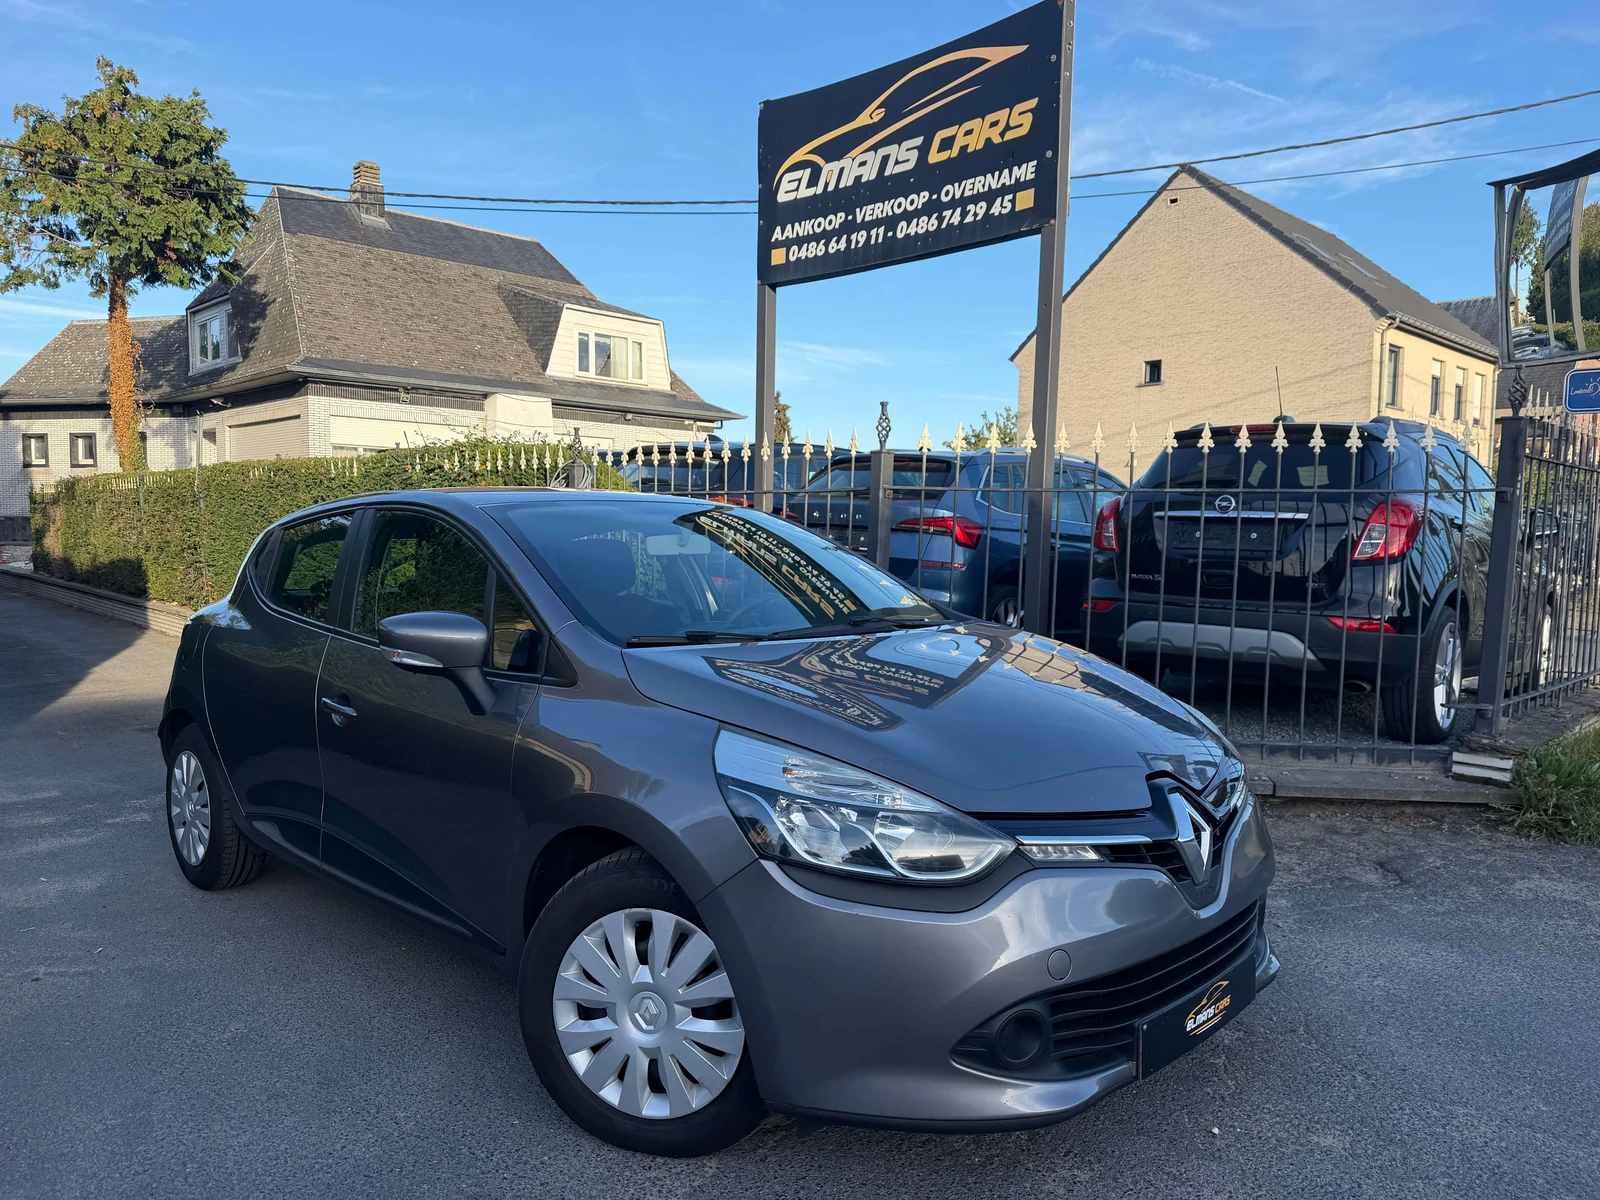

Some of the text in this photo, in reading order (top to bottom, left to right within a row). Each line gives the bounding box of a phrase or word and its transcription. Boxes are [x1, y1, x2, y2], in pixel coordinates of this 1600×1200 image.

[777, 97, 1039, 203] ELMANS CARS
[771, 214, 844, 242] AANKOOP
[856, 191, 929, 222] VERKOOP
[940, 161, 1037, 203] OVERNAME
[789, 241, 825, 262] 0486
[828, 239, 847, 254] 64
[850, 232, 868, 249] 19
[870, 228, 885, 244] 11
[896, 214, 938, 239] 0486
[942, 209, 961, 228] 74
[966, 201, 986, 222] 29
[989, 195, 1012, 216] 45
